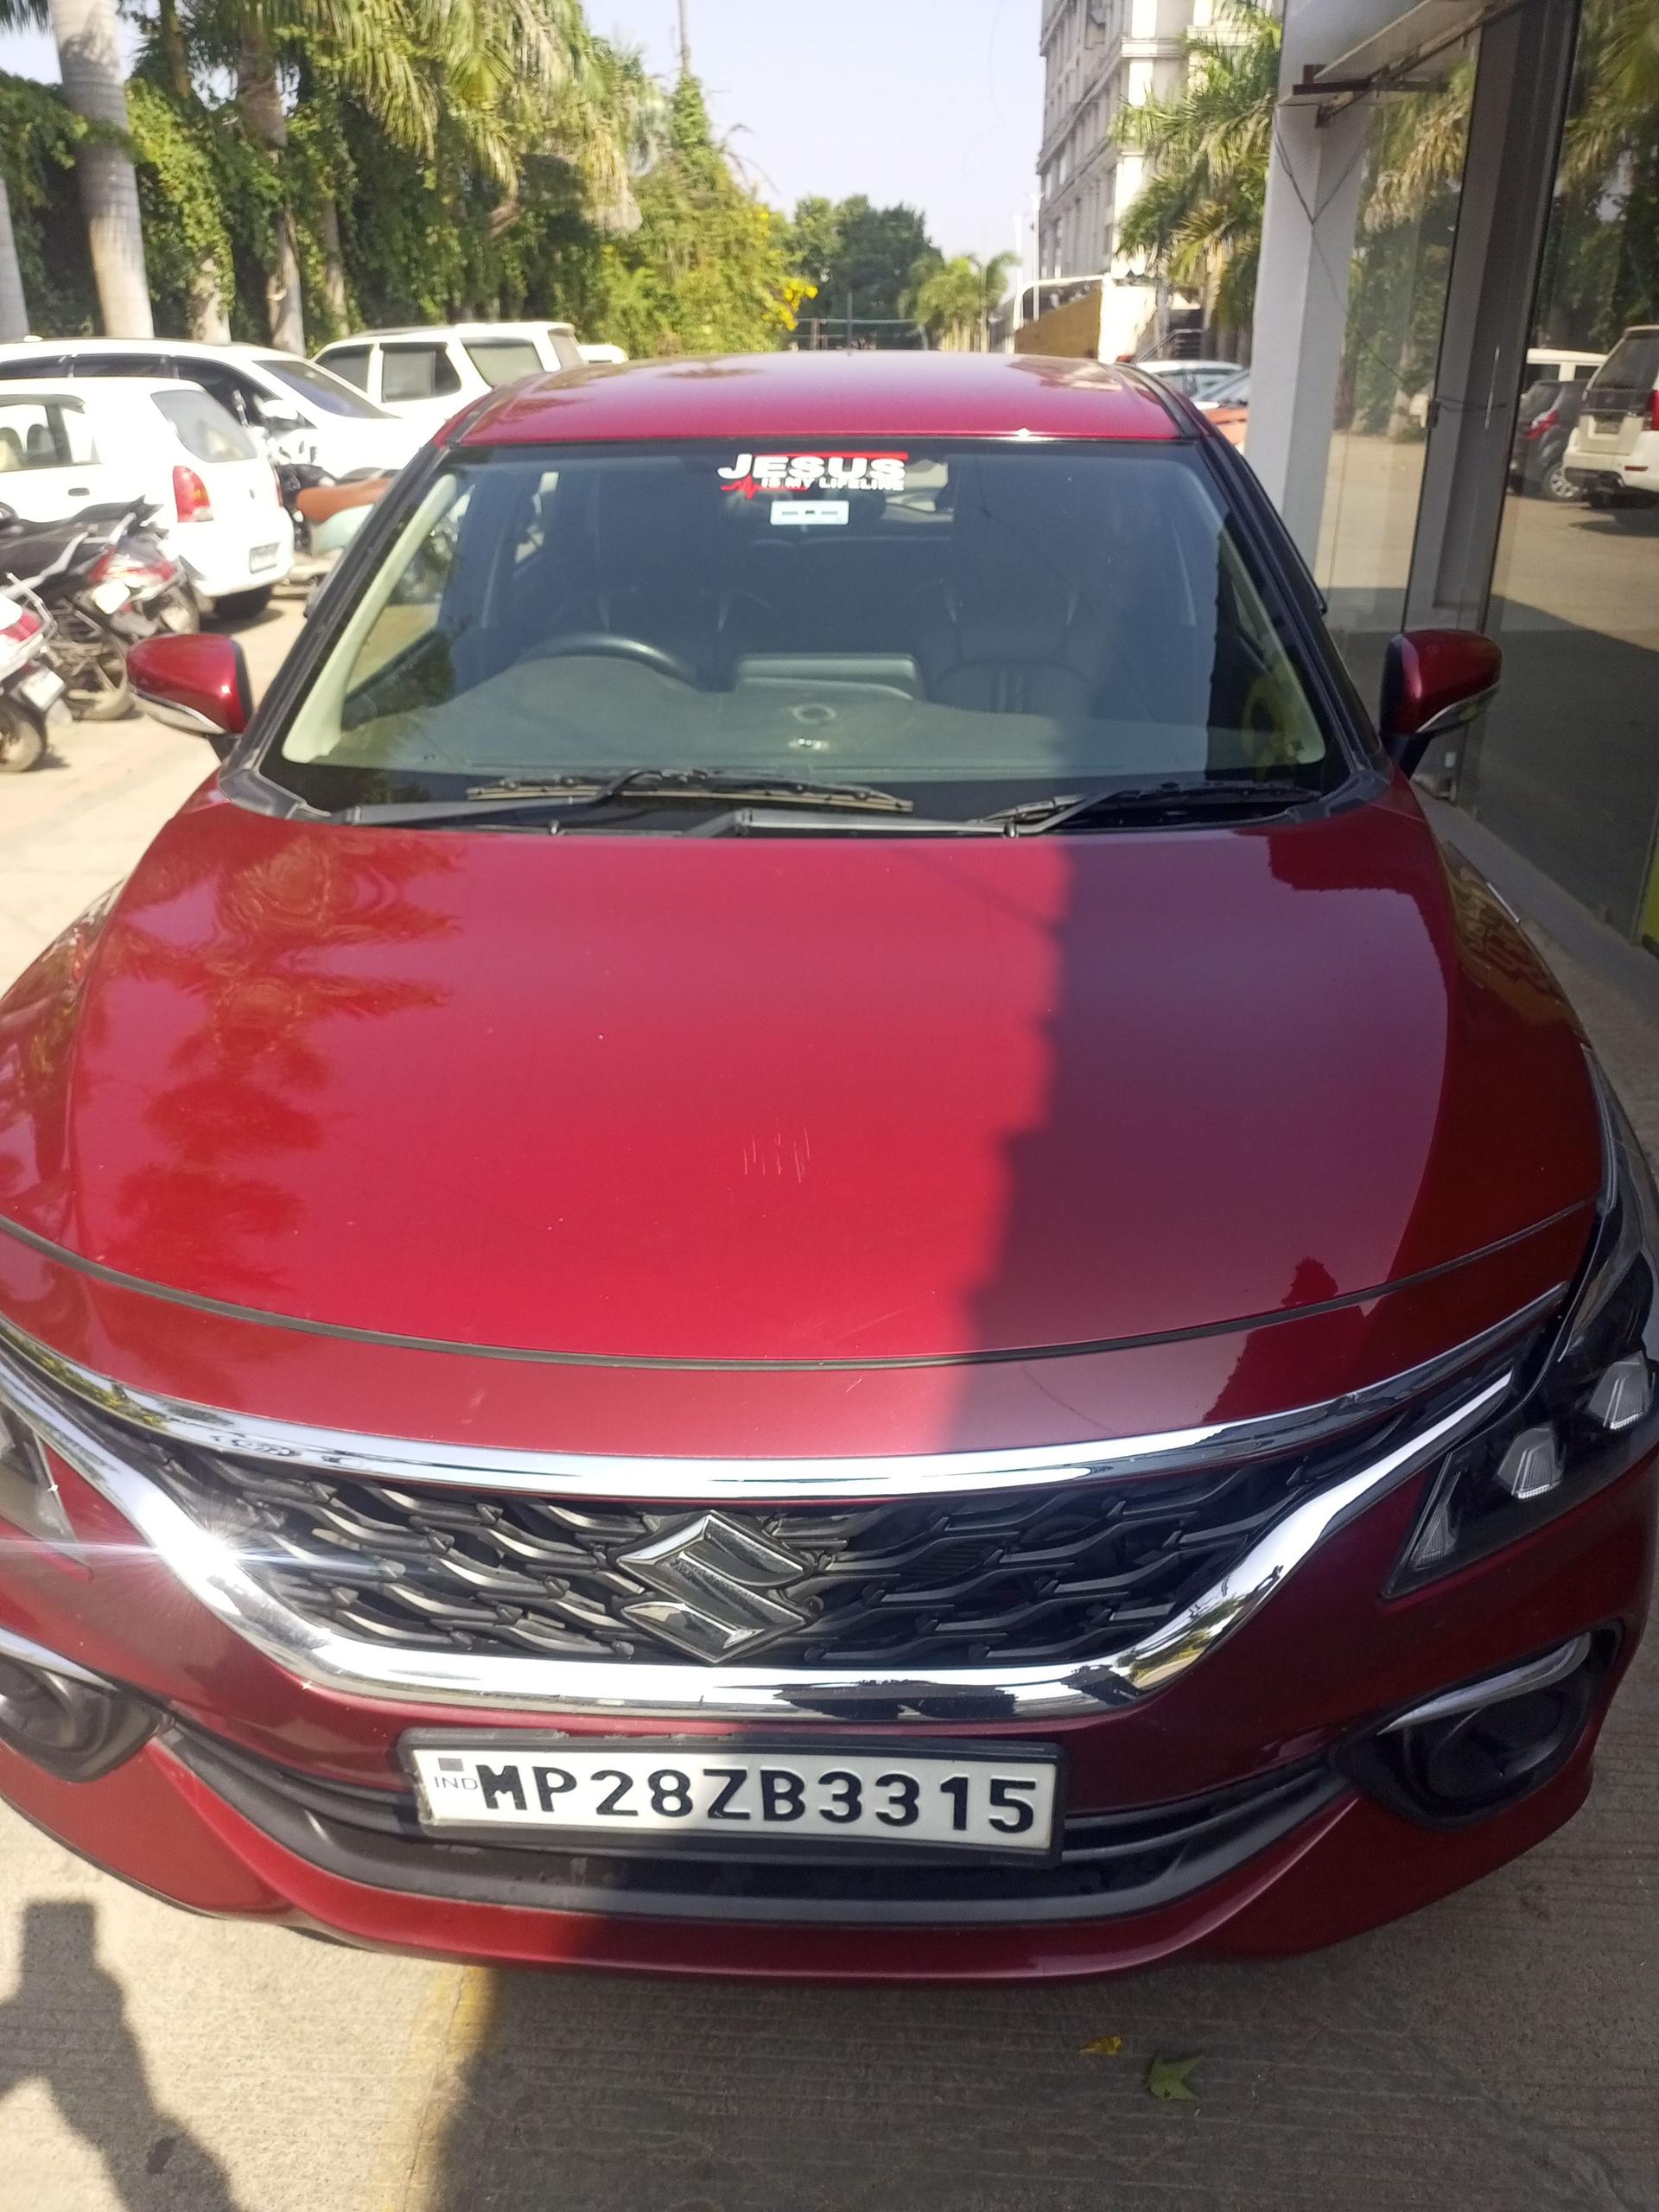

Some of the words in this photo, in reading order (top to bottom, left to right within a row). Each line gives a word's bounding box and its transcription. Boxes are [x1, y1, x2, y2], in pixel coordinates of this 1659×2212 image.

[717, 454, 906, 480] JESUS
[760, 477, 781, 488] IS
[785, 477, 815, 489] MY
[435, 1775, 478, 1791] IND
[475, 1764, 1037, 1834] MP28ZB3315
